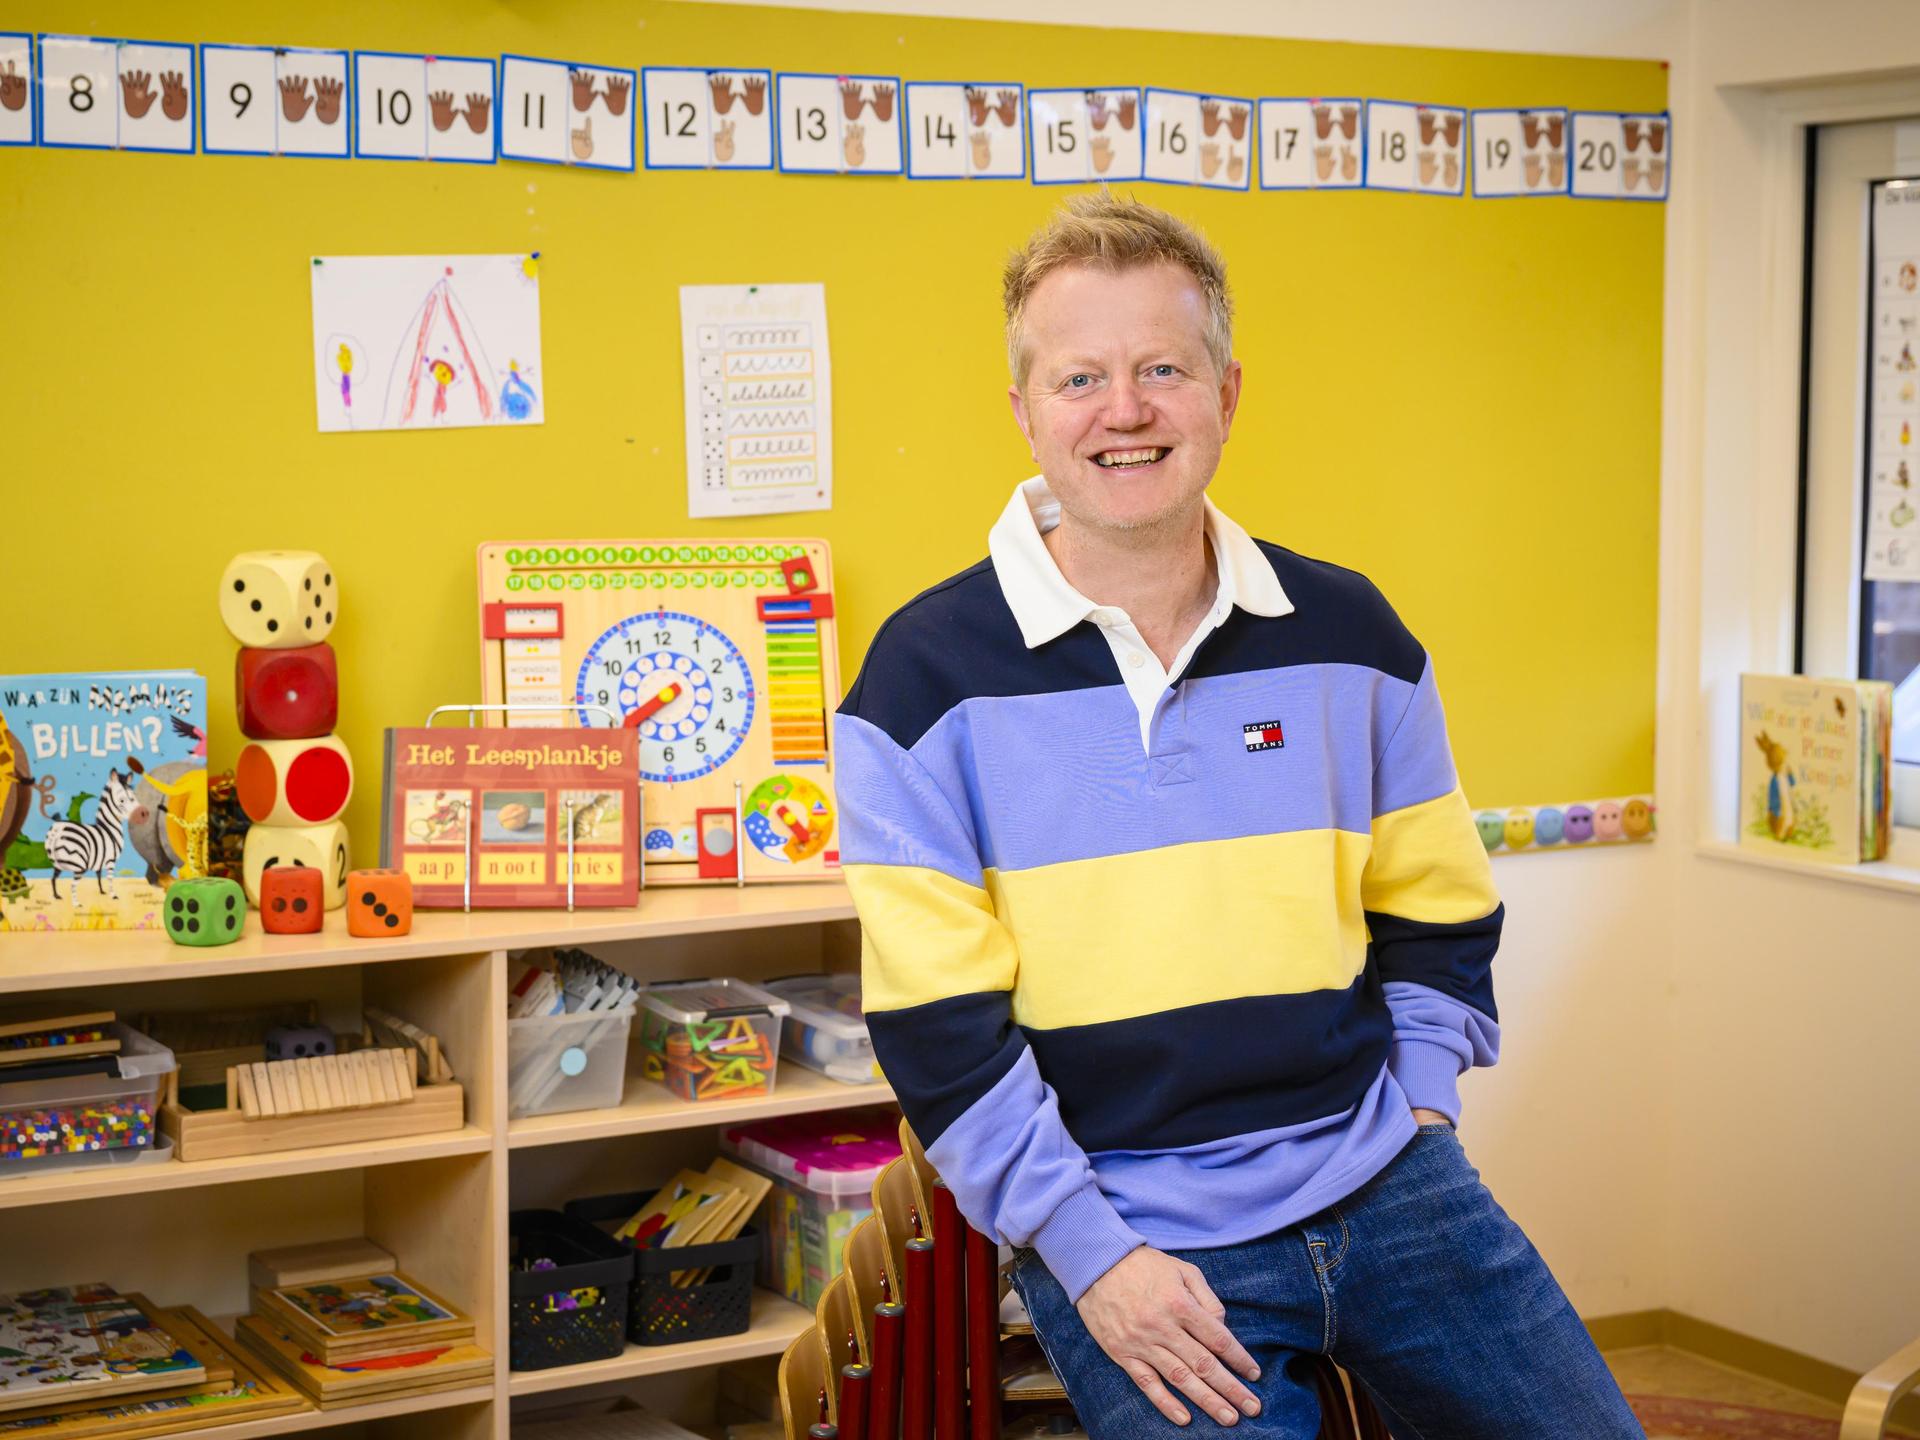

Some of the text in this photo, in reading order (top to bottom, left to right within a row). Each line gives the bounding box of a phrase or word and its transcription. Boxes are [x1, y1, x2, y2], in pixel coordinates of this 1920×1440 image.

[69, 75, 94, 112] 8
[230, 83, 252, 119] 9
[377, 89, 412, 125] 10
[524, 93, 545, 129] 11
[664, 103, 697, 136] 12
[797, 109, 827, 141] 13
[925, 116, 956, 148] 14
[1048, 121, 1076, 153] 15
[1160, 123, 1186, 154] 16
[1275, 130, 1298, 159] 17
[1381, 133, 1406, 162] 18
[1486, 139, 1510, 168] 19
[1580, 141, 1616, 171] 20
[625, 640, 641, 655] 11
[654, 632, 671, 646] 12
[693, 639, 700, 654] 1
[604, 660, 622, 676] 10
[712, 659, 722, 674] 2
[5, 690, 46, 708] WAAR
[88, 682, 193, 718] MAMA'S
[598, 690, 609, 705] 9
[722, 687, 733, 702] 3
[715, 718, 726, 732] 4
[1245, 723, 1278, 731] TOMMY
[406, 743, 623, 771] Het Leesplankje
[664, 747, 674, 762] 6
[696, 738, 706, 753] 5
[1249, 741, 1282, 750] JEANS
[337, 843, 346, 888] 2
